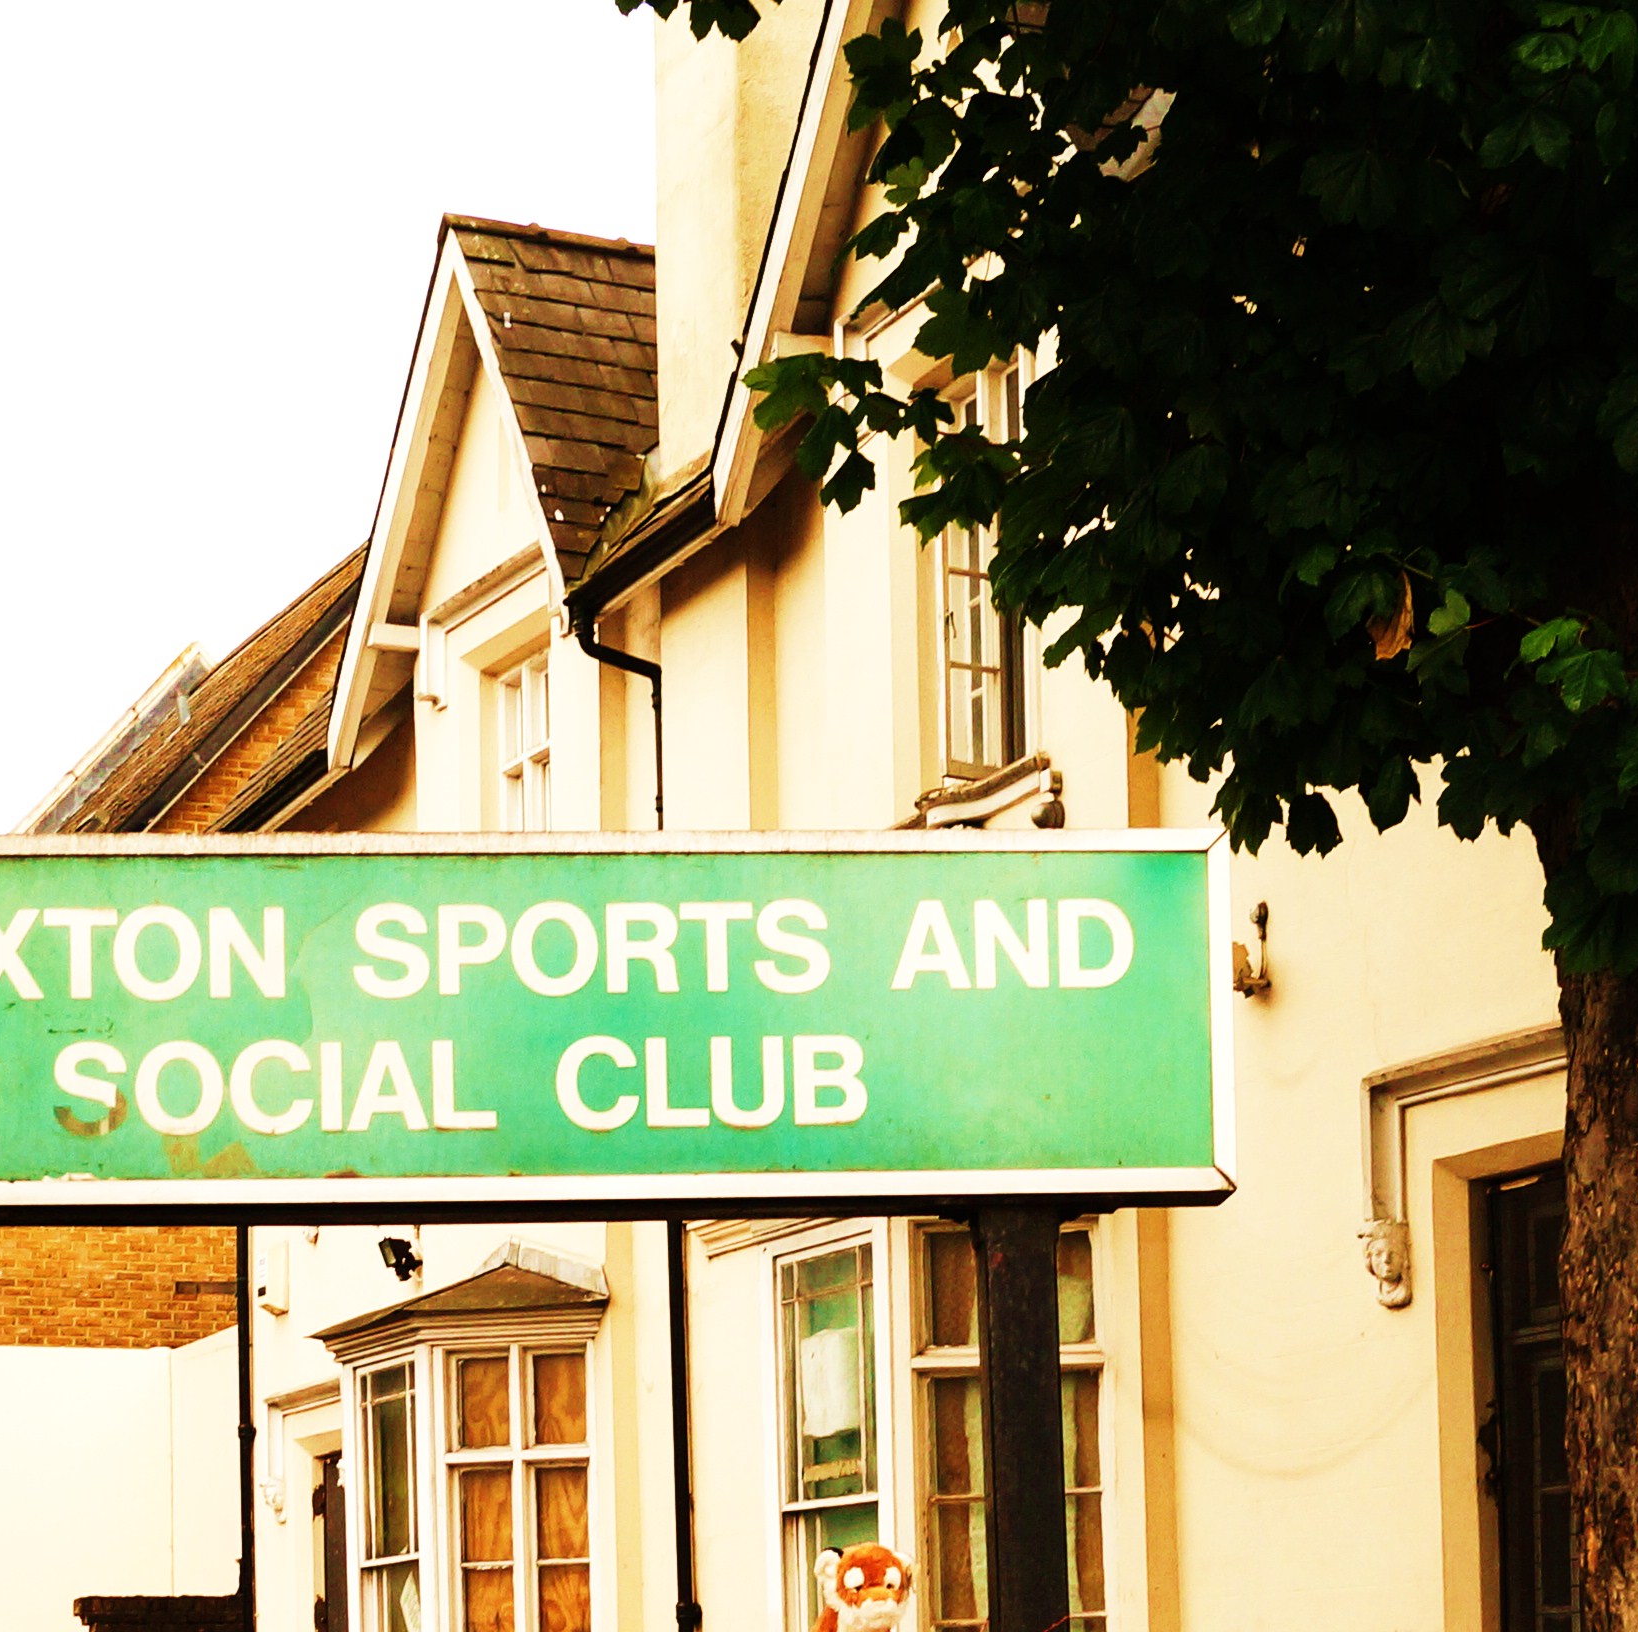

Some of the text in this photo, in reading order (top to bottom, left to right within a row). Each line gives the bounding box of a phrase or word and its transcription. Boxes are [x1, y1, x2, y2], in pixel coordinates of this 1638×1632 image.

[352, 897, 832, 998] SPORTS
[891, 896, 1136, 991] AND
[51, 1033, 869, 1138] SOCIAL CLUB
